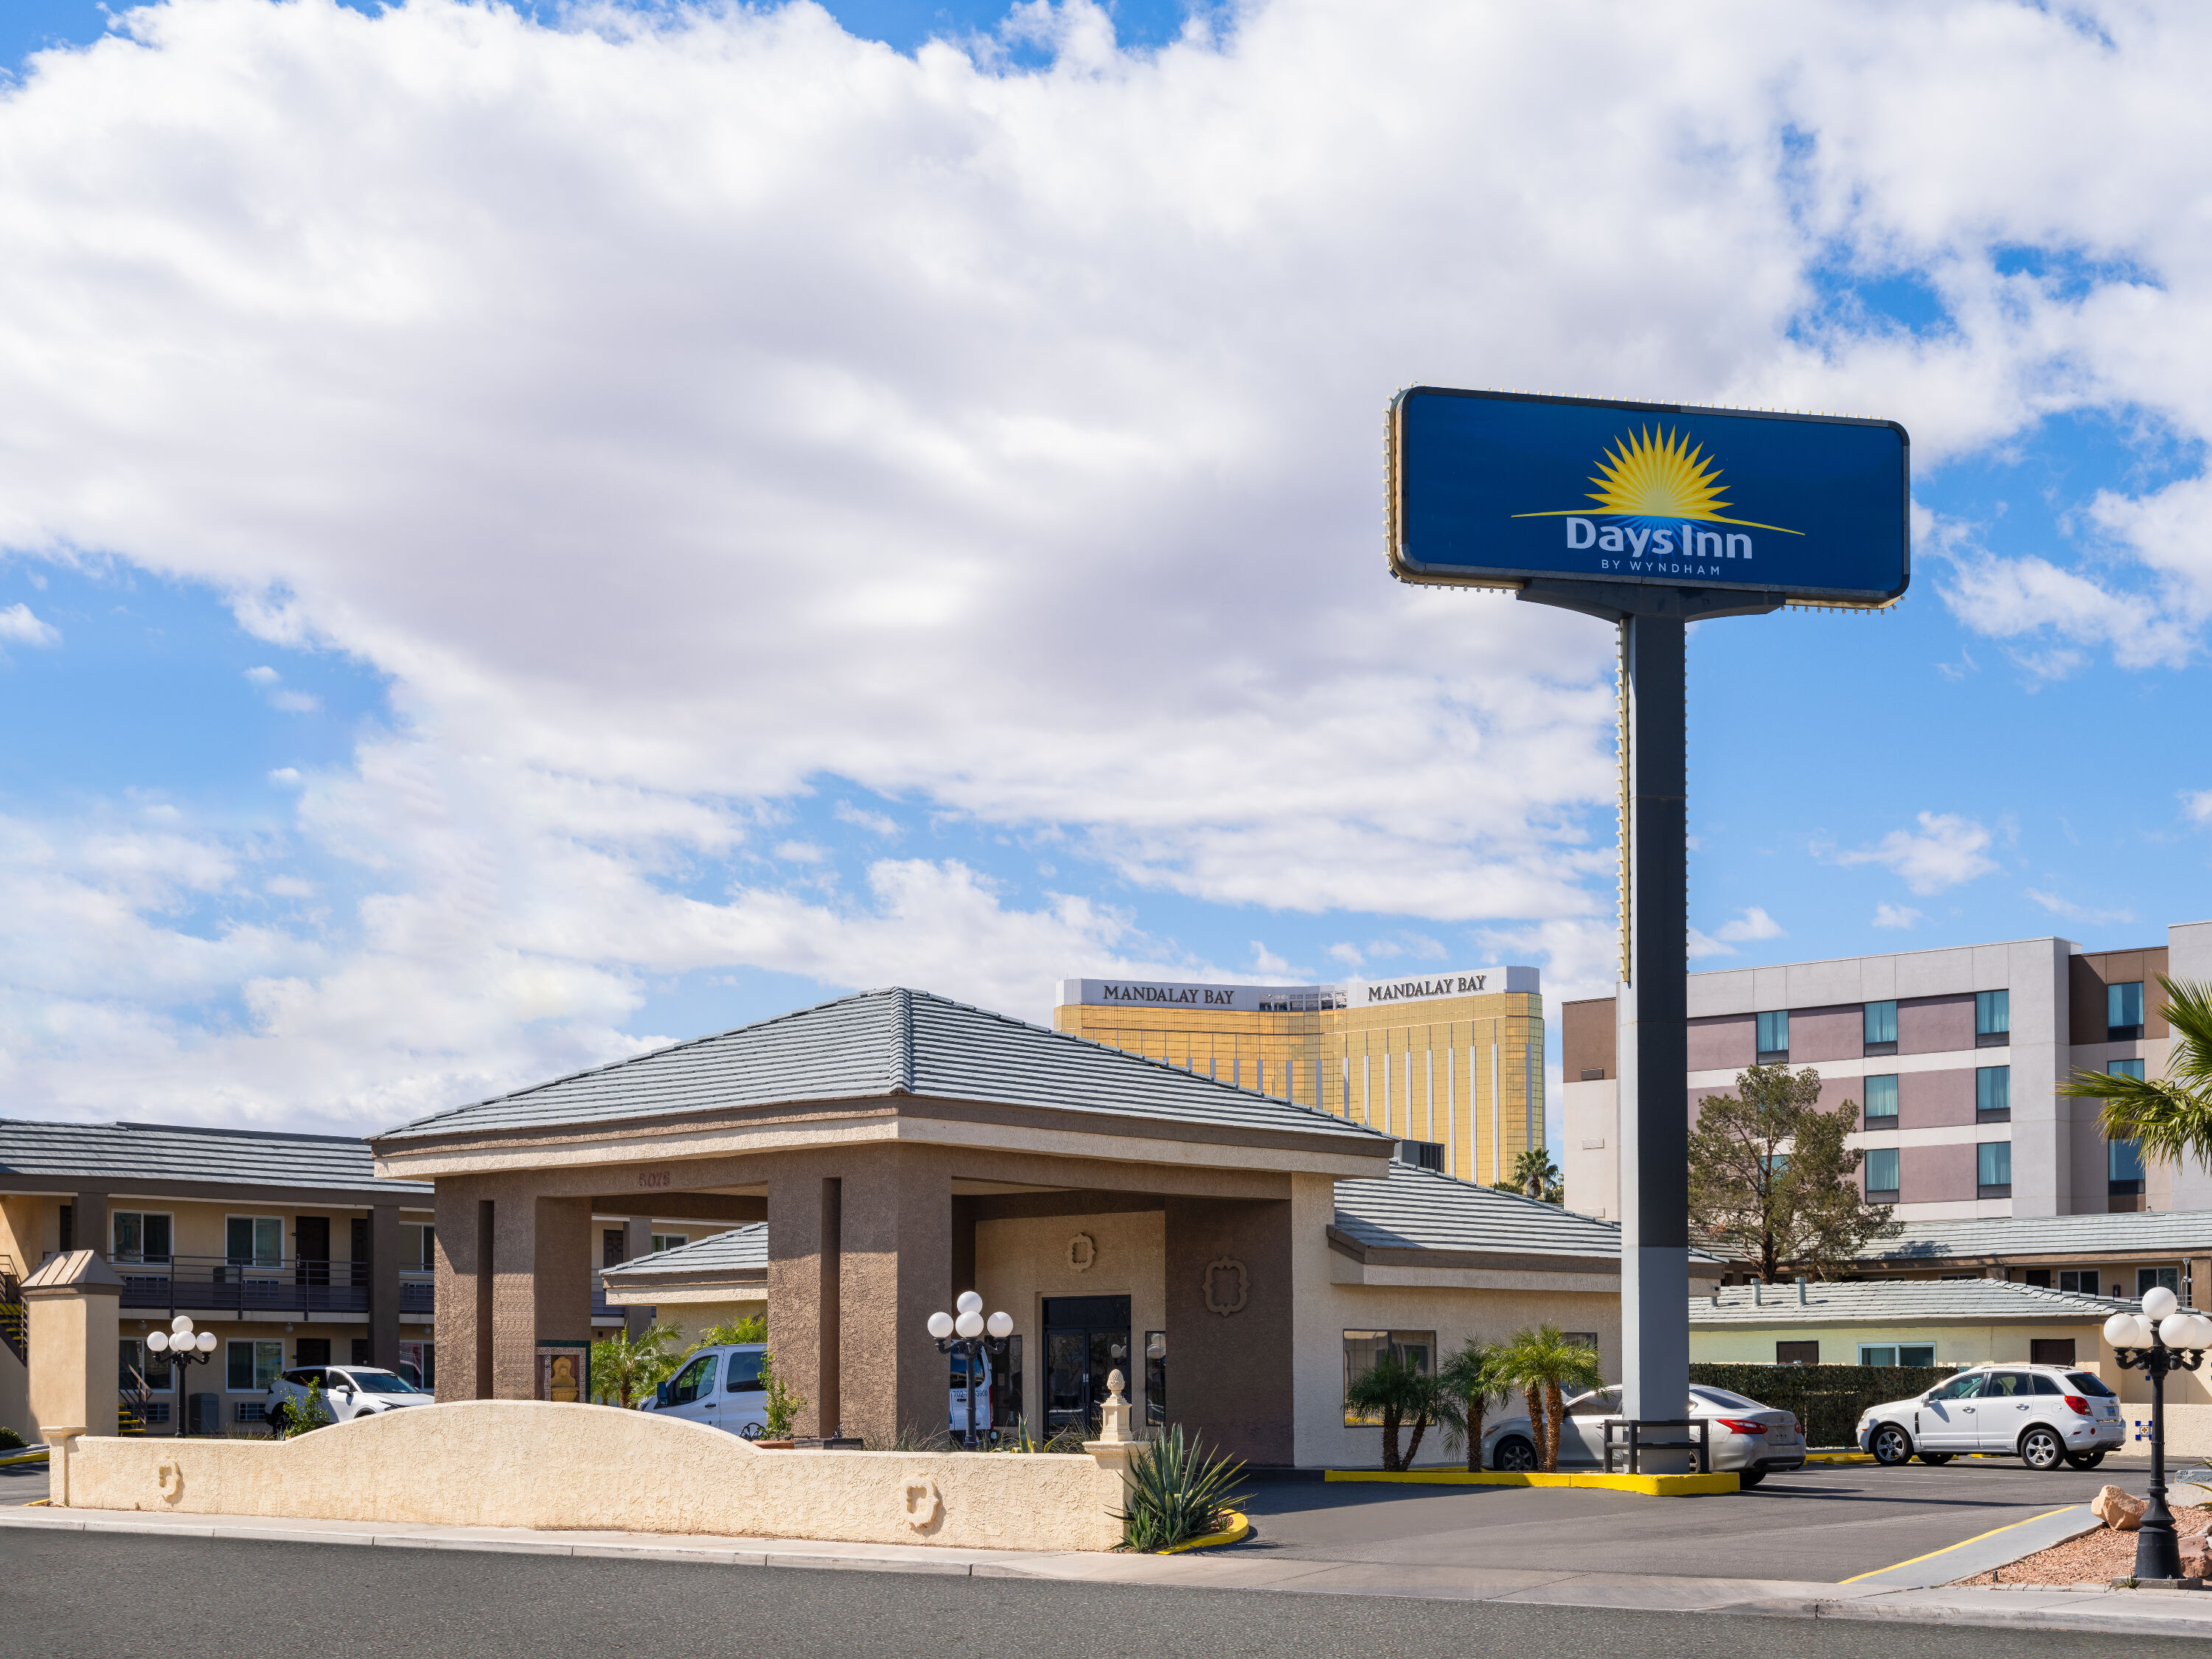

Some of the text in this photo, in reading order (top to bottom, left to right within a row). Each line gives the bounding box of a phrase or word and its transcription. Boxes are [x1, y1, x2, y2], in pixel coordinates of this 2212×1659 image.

[1566, 517, 1753, 559] Days Inn
[1601, 559, 1720, 575] BY WYNDHAM
[1102, 985, 1235, 1004] MANDALAY BAY
[1368, 975, 1487, 1001] MANDALAY BAY
